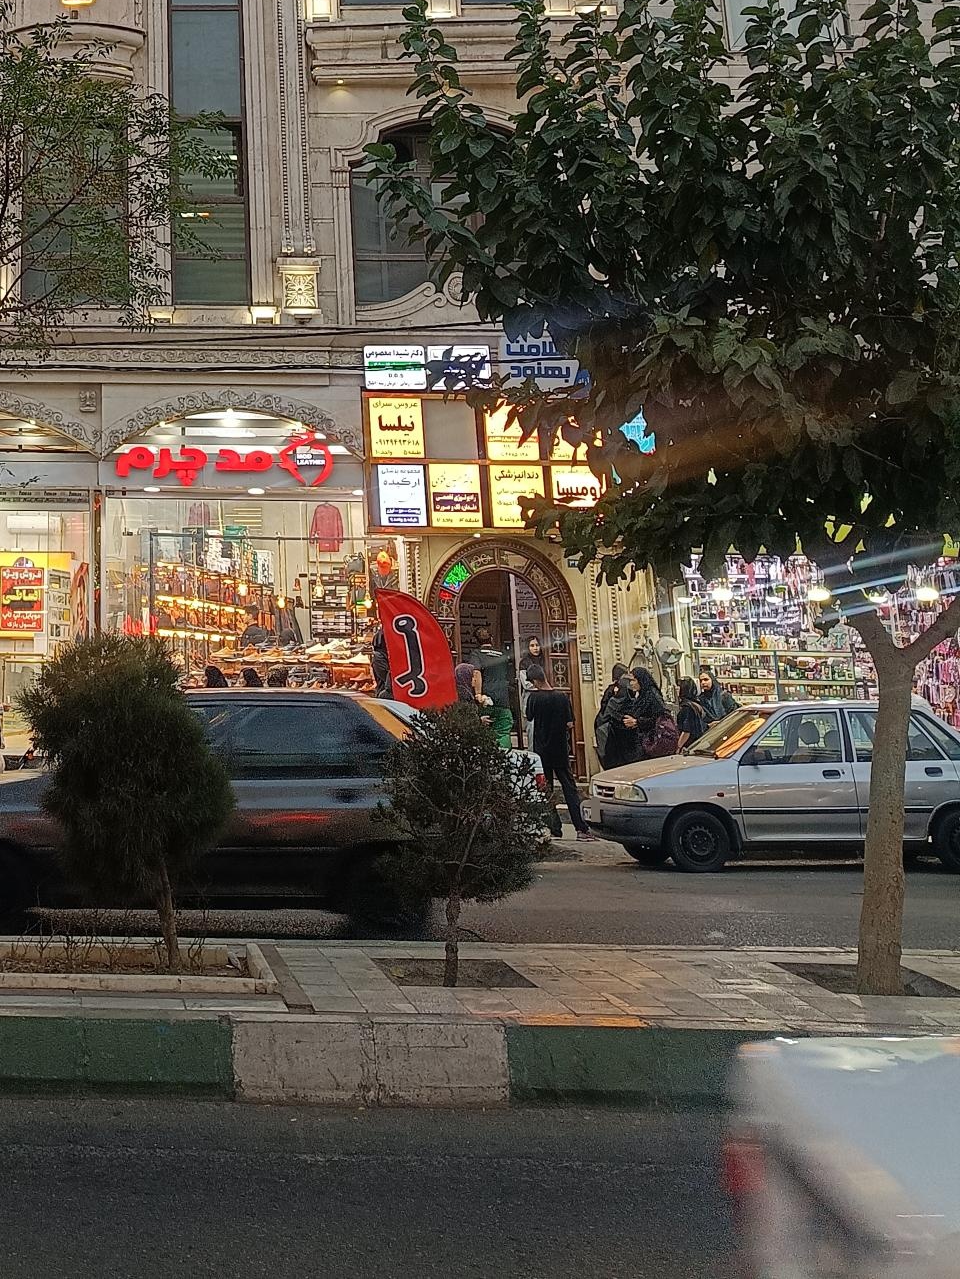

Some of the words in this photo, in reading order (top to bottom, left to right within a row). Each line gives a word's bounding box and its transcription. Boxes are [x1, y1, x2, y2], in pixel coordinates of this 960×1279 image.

[393, 348, 409, 358] شیدا
[410, 348, 423, 358] دکتر
[506, 340, 558, 356] لامت
[372, 401, 393, 409] سرای
[395, 401, 418, 409] عروس
[378, 414, 415, 436] نیلسا
[215, 448, 274, 472] مد
[115, 446, 208, 487] چرم
[494, 469, 540, 482] دندانپزشکی
[384, 477, 421, 488] ارکیده
